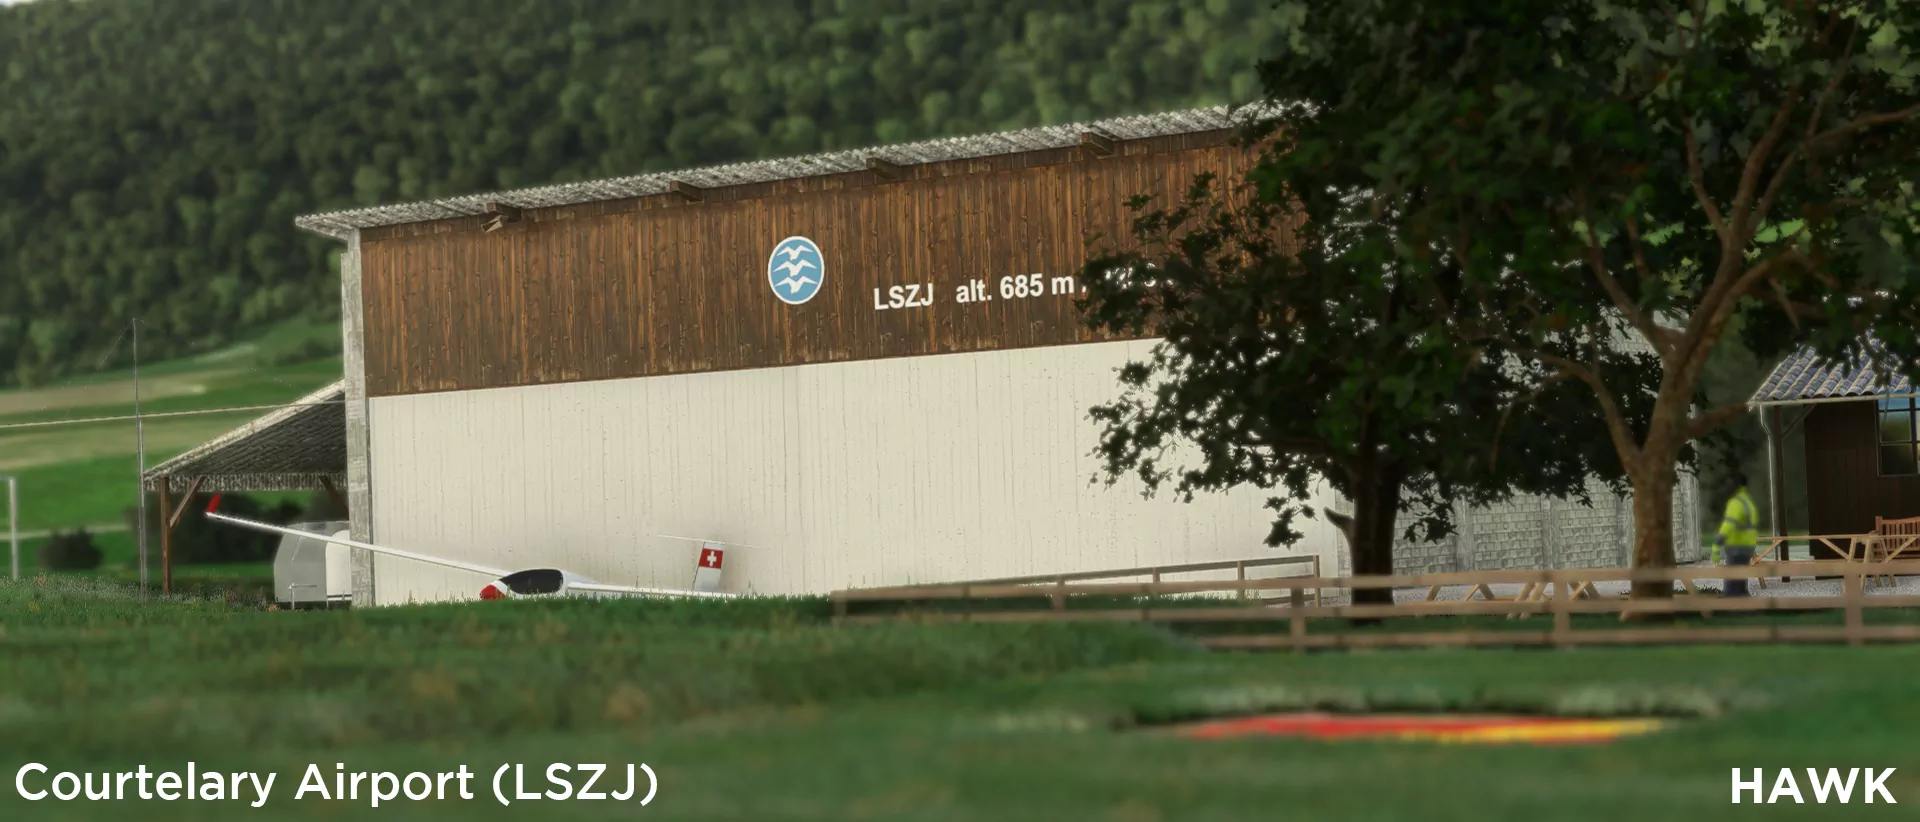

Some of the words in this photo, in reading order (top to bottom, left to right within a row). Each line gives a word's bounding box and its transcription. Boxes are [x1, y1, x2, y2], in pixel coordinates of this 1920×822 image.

[873, 282, 934, 311] LSZJ
[955, 278, 993, 304] alt.
[999, 272, 1044, 300] 685
[1051, 275, 1075, 296] m
